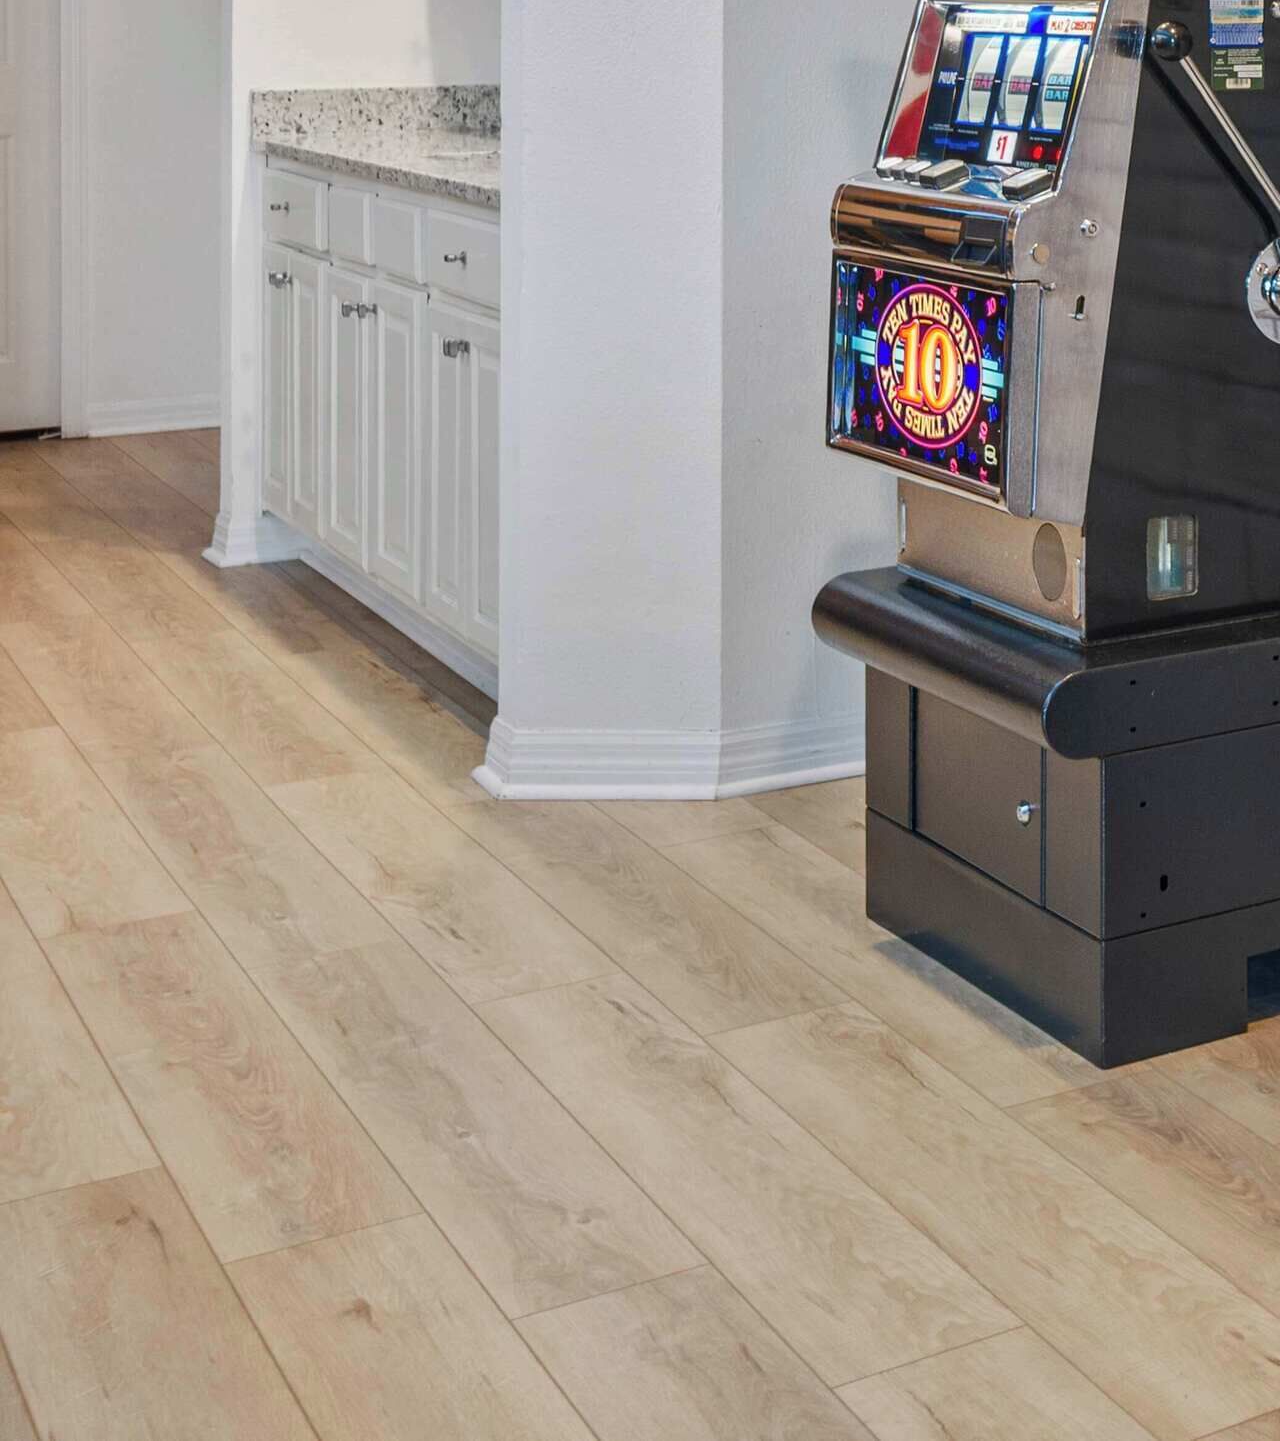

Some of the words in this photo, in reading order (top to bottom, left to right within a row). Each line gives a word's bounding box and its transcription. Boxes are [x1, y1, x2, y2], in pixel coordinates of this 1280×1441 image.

[997, 134, 1008, 160] $1
[882, 299, 907, 343] TEN
[908, 292, 951, 323] TIMES
[951, 310, 976, 365] PAY
[895, 318, 958, 414] 10
[880, 365, 903, 419] PAY
[948, 387, 975, 435] TEN
[904, 405, 945, 438] TIMES
